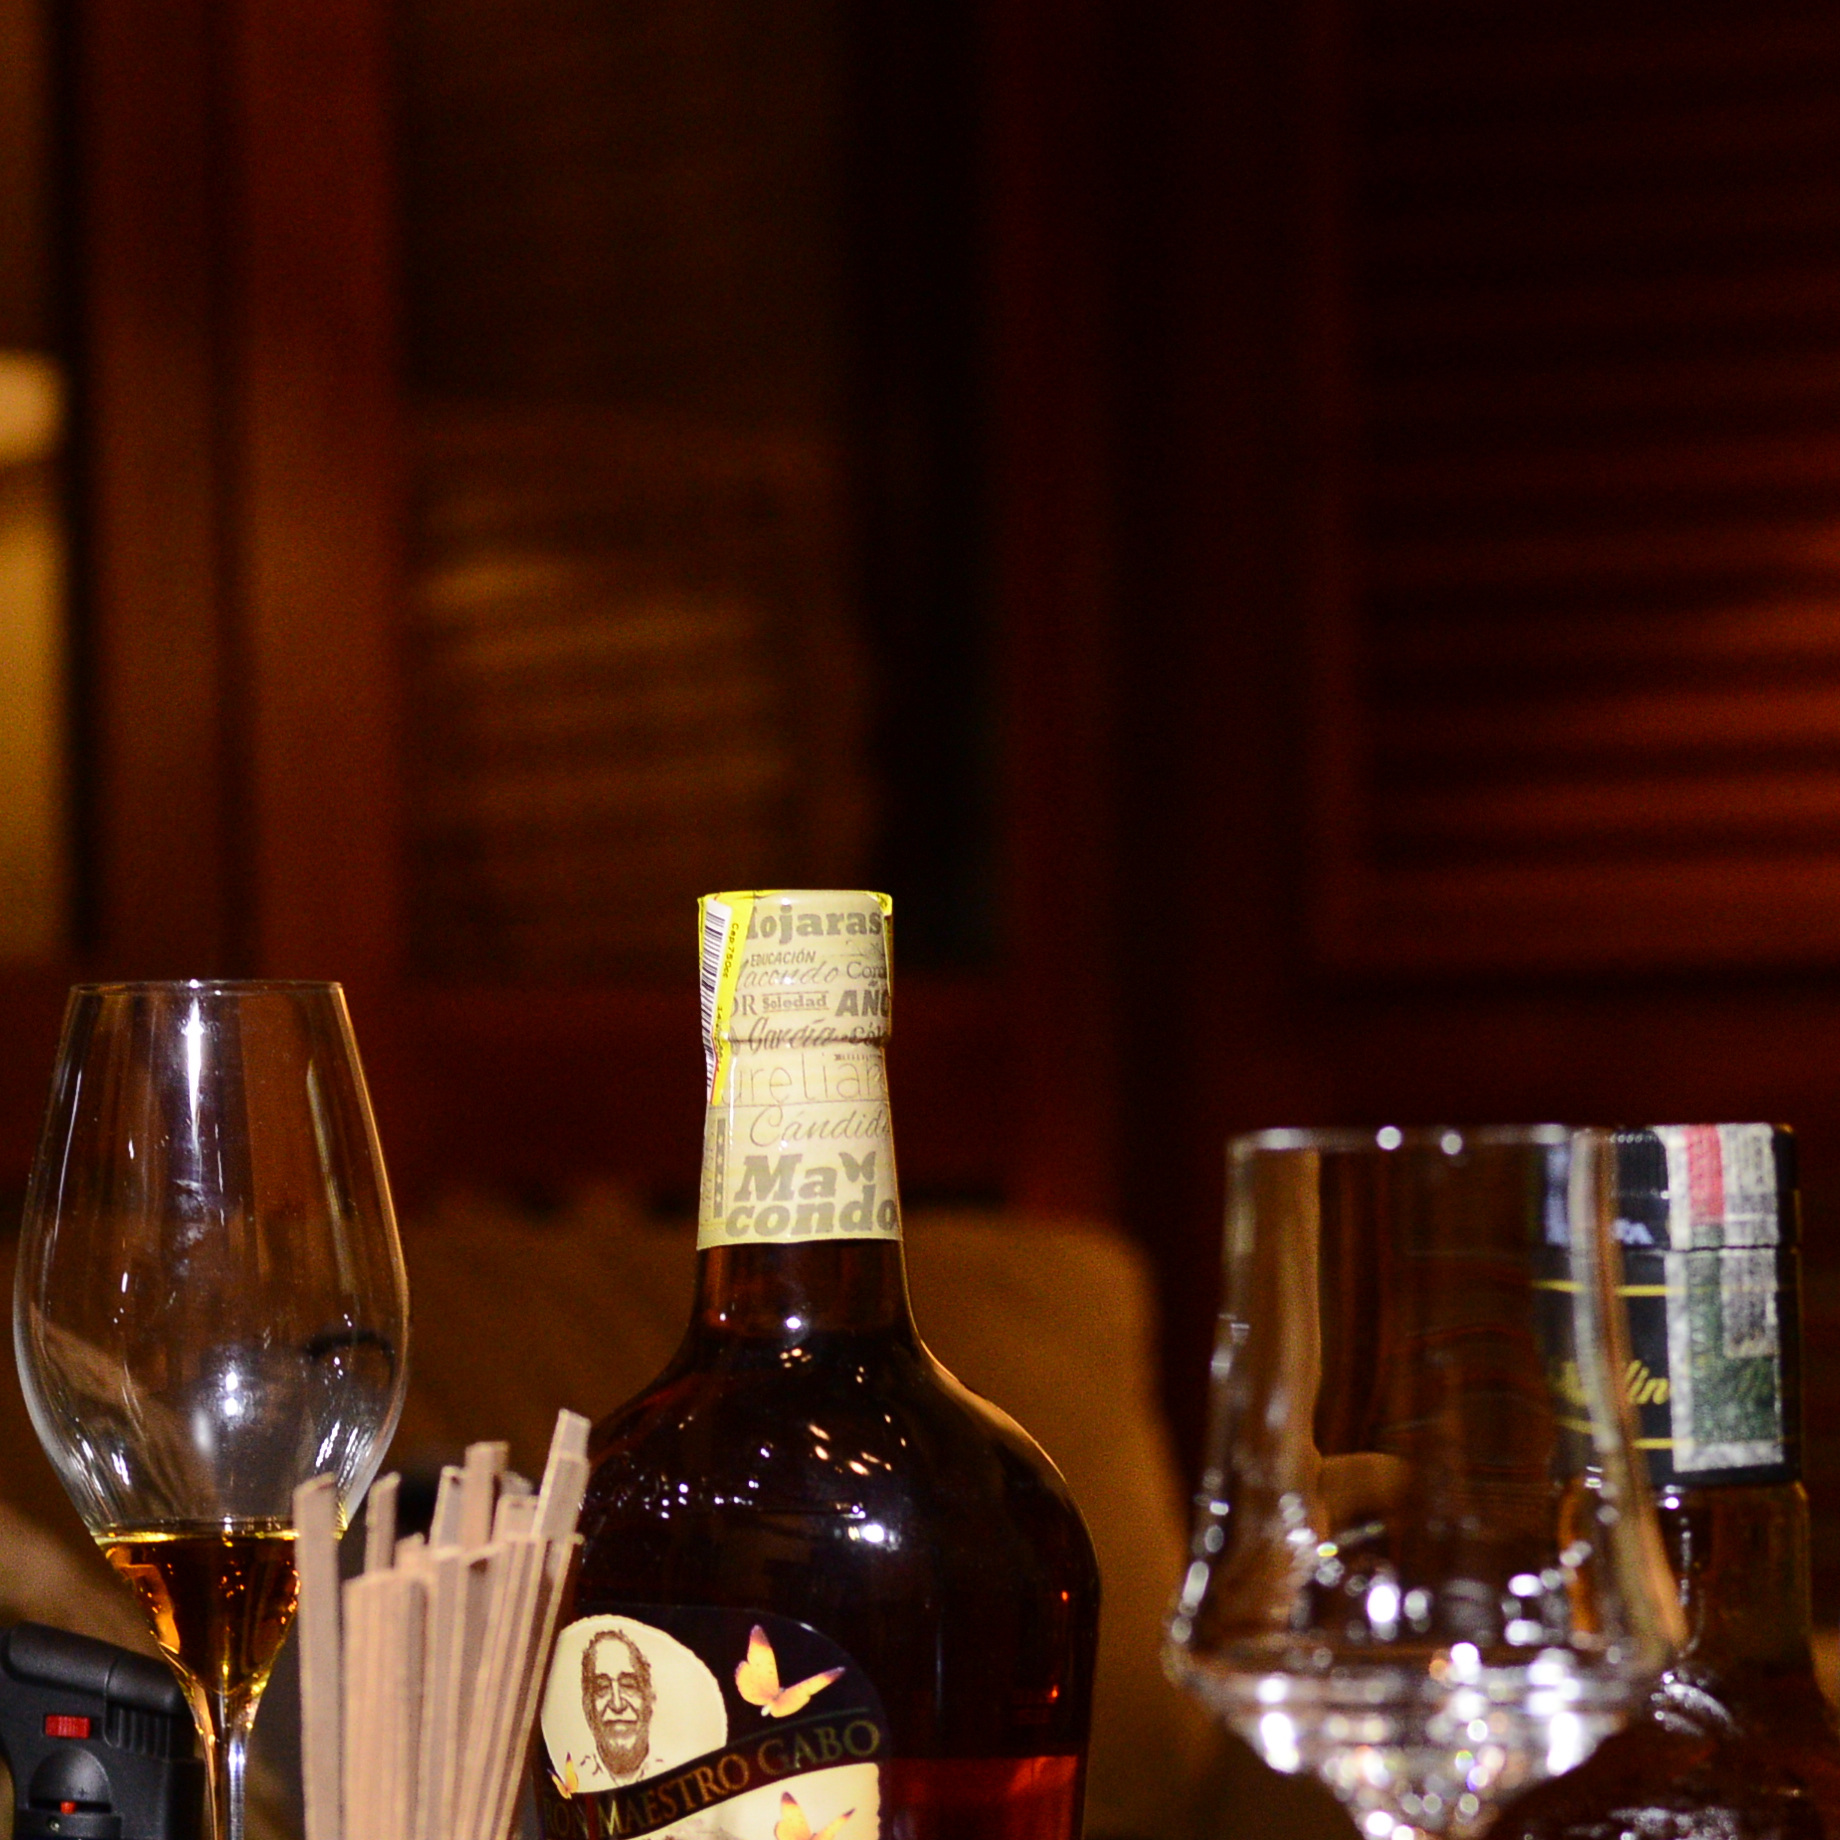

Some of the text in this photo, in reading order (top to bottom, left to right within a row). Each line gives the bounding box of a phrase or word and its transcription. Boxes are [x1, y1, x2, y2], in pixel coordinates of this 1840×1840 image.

[751, 949, 817, 967] EDUCACIÓN
[762, 994, 828, 1011] Soledad
[749, 1016, 843, 1054] García
[722, 1053, 885, 1105] urelian
[734, 1153, 838, 1202] Ma
[725, 1184, 898, 1237] condo
[597, 1754, 750, 1838] MAESTRO
[760, 1719, 880, 1776] GABO
